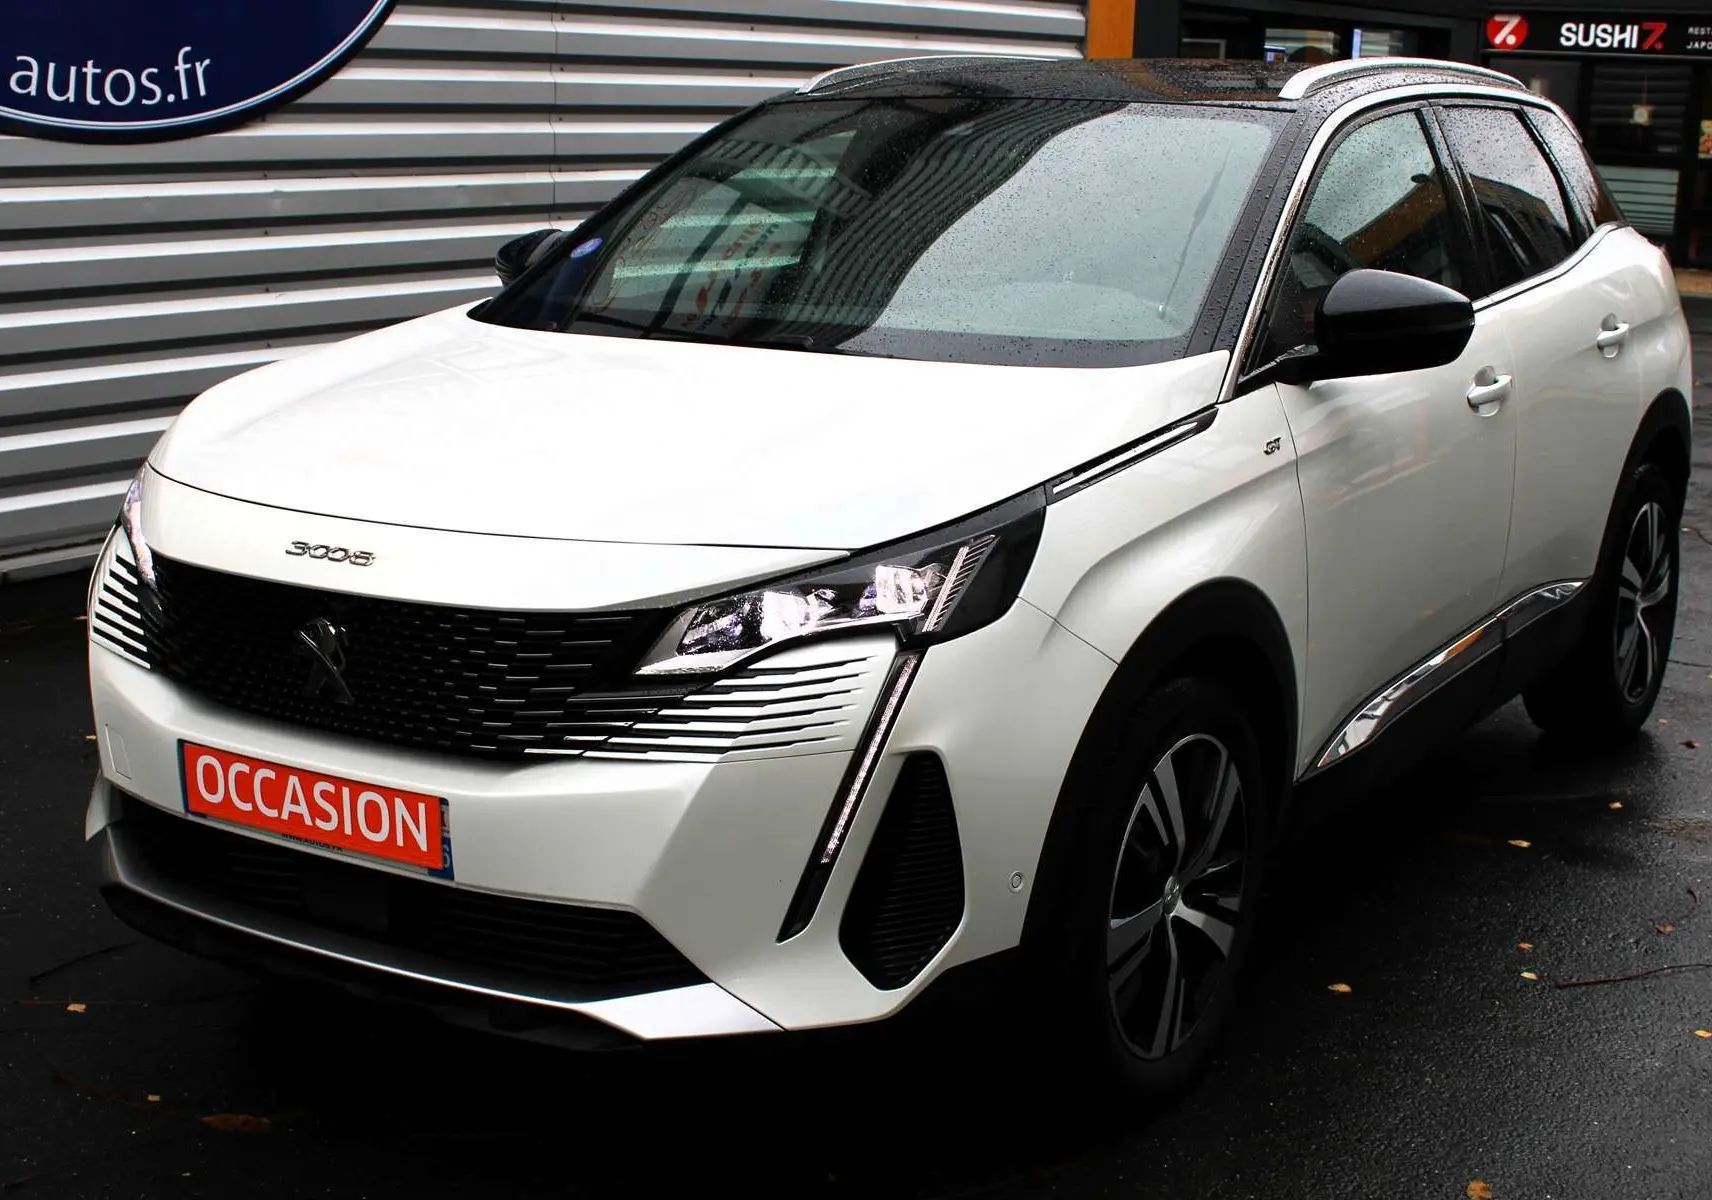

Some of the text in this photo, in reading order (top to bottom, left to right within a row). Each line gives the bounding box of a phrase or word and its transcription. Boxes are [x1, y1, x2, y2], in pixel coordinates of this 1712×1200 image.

[9, 46, 211, 106] autos.fr
[1264, 436, 1281, 455] GT
[196, 754, 428, 853] OCCASION
